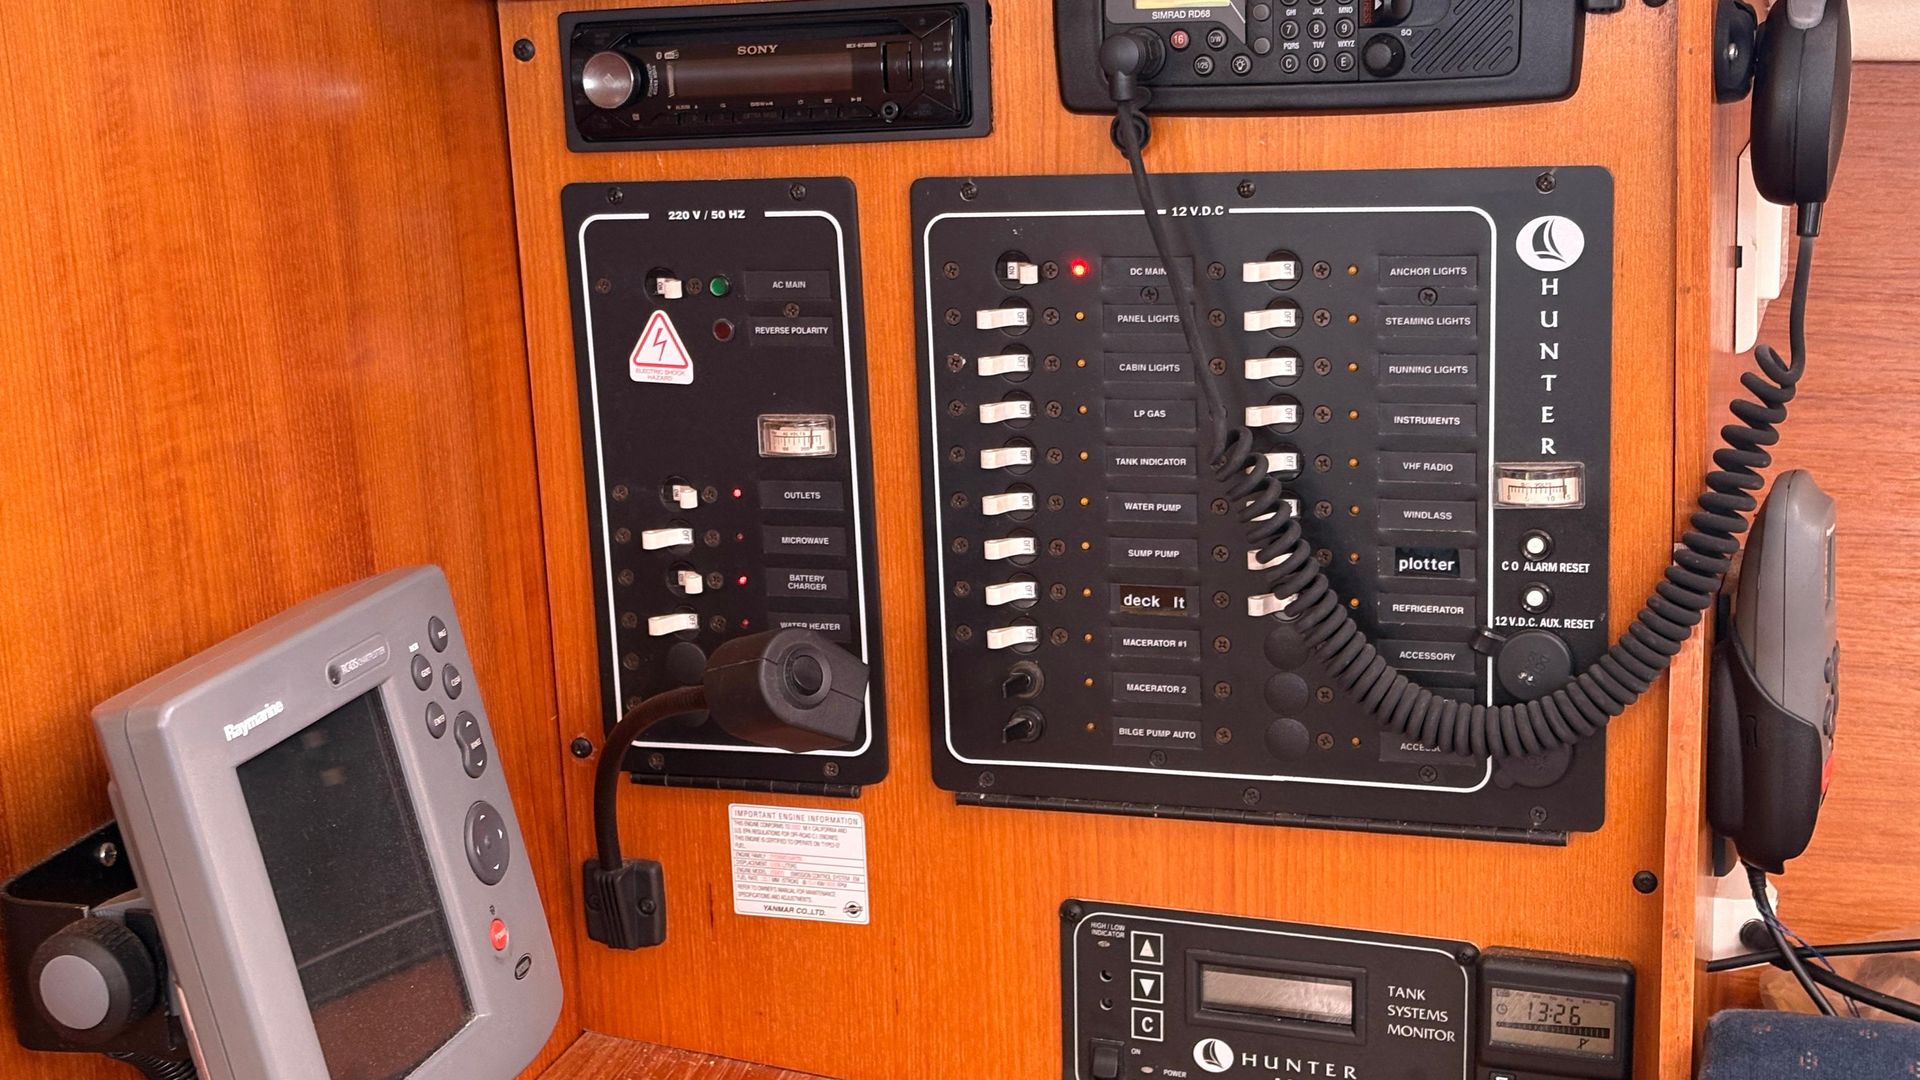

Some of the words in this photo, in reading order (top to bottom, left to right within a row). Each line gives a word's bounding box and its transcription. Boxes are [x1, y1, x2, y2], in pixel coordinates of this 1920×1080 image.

[1152, 10, 1186, 20] SIMRAD
[1188, 10, 1211, 18] RD68
[1286, 25, 1292, 34] 7
[1313, 24, 1319, 34] 8
[1341, 24, 1347, 33] 9
[1173, 34, 1183, 44] 16
[737, 44, 778, 55] SONY
[1286, 58, 1292, 68] C
[1340, 57, 1347, 66] E
[668, 210, 690, 220] 220
[692, 210, 701, 220] V
[703, 210, 709, 220] /
[711, 209, 726, 220] 50
[728, 209, 746, 219] HZ
[1129, 267, 1143, 276] DC
[1389, 267, 1431, 276] ANCHOR
[1432, 266, 1468, 276] LIGHTS
[772, 280, 784, 289] AC
[785, 280, 806, 289] MAIN
[1117, 314, 1146, 323] PANEL
[1147, 314, 1180, 323] LIGHTS
[1385, 316, 1435, 326] STEAMING
[1436, 317, 1471, 326] LIGHTS
[754, 326, 790, 335] REVERSE
[790, 326, 829, 335] POLARITY
[1119, 363, 1147, 372] CABIN
[1148, 363, 1181, 373] LIGHTS
[1388, 365, 1432, 374] RUNNING
[1433, 365, 1469, 374] LIGHTS
[1539, 277, 1559, 455] HUNTER
[1133, 409, 1146, 418] LP
[1146, 409, 1167, 418] GAS
[1393, 415, 1461, 426] INSTRUMENTS
[1115, 457, 1139, 466] TANK
[1140, 457, 1187, 466] INDICATOR
[1402, 462, 1422, 470] VHF
[1423, 462, 1454, 472] RADIO
[783, 491, 821, 500] OUTLETS
[1124, 502, 1155, 511] WATER
[1156, 503, 1182, 512] PUMP
[1403, 510, 1453, 520] WINDLASS
[781, 536, 830, 545] MICROWAVE
[1127, 549, 1153, 557] SUMP
[1154, 549, 1180, 558] PUMP
[1398, 557, 1456, 572] plotter
[1523, 559, 1558, 573] ALARM
[1559, 562, 1591, 574] RESET
[789, 574, 825, 583] BATTERY
[787, 582, 827, 591] CHARGER
[1123, 593, 1160, 608] deck
[1392, 603, 1464, 615] REFRIGERATOR
[808, 622, 841, 631] HEATER
[1539, 617, 1562, 628] AUX.
[1563, 618, 1595, 630] RESET
[1122, 638, 1176, 648] MACERATOR
[1177, 640, 1187, 648] #1
[1399, 650, 1456, 661] ACCESSORY
[1126, 683, 1180, 693] MACERATOR
[1181, 686, 1187, 694] 2
[224, 701, 283, 741] Raymarine
[1118, 727, 1145, 737] BILGE
[1146, 729, 1171, 737] PUMP
[1172, 730, 1196, 740] AUTO
[735, 810, 776, 819] IMPORTANT
[779, 813, 805, 822] ENGINE
[808, 815, 858, 825] INFORMATION
[1091, 929, 1125, 938] INDICATOR
[1387, 985, 1426, 1001] TANK
[1387, 1004, 1449, 1023] SYSTEMS
[1528, 1001, 1581, 1026] 13:26
[1141, 1016, 1154, 1032] C
[1387, 1023, 1456, 1042] MONITOR
[1242, 1052, 1357, 1080] HUNTER
[1163, 1069, 1187, 1078] POWER
